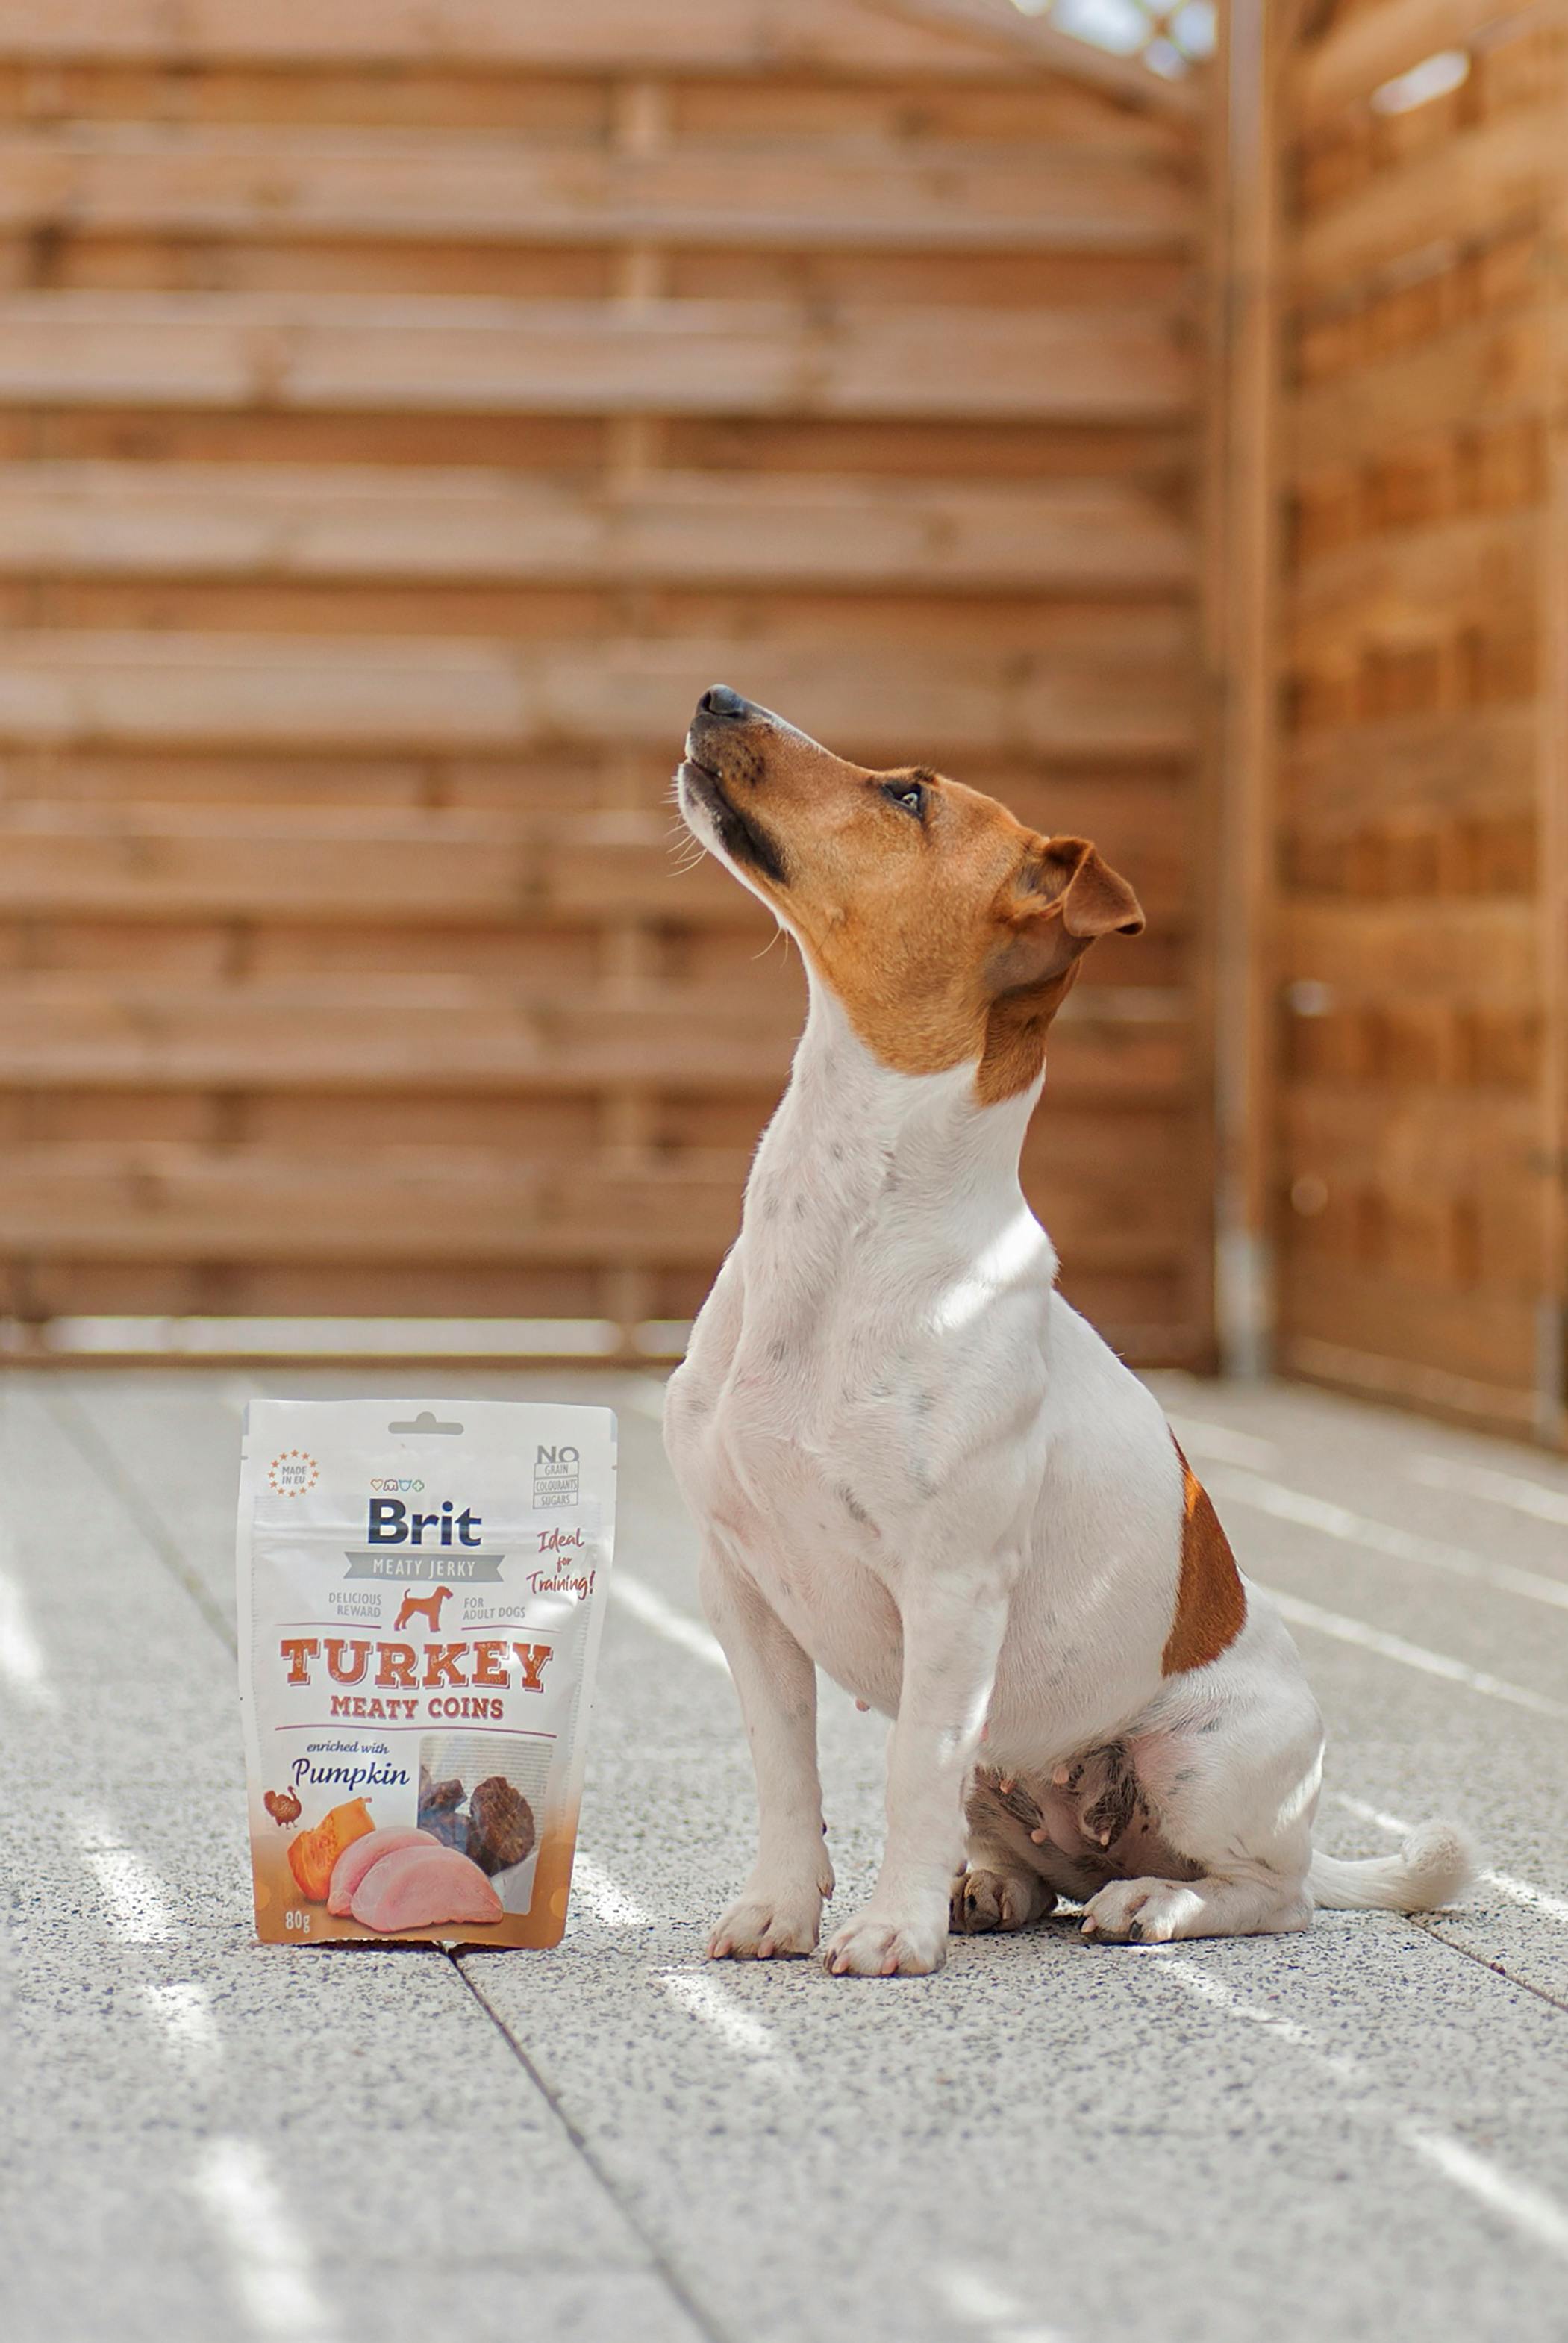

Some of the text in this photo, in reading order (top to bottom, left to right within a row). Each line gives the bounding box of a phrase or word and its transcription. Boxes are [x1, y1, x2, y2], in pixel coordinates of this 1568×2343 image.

[537, 1445, 580, 1464] NO
[282, 1466, 307, 1475] MADE
[545, 1464, 569, 1476] GRAIN
[281, 1476, 305, 1484] IN EU
[536, 1479, 578, 1491] COLOURANTS
[541, 1494, 571, 1506] SUGARS
[368, 1498, 482, 1547] Brit
[537, 1528, 584, 1553] Ideal
[373, 1559, 475, 1579] MEATY JERKY
[557, 1556, 572, 1573] for
[526, 1570, 596, 1600] Training!
[328, 1592, 382, 1606] DELICIOUS
[464, 1597, 484, 1608] FOR
[337, 1605, 381, 1618] REWARD
[463, 1606, 525, 1620] ADULT DOGS
[280, 1638, 555, 1693] TURKEY
[330, 1695, 504, 1720] MEATY COINS
[307, 1740, 390, 1754] enriched with
[292, 1758, 410, 1791] Pumpkin
[285, 1910, 310, 1935] 80g
